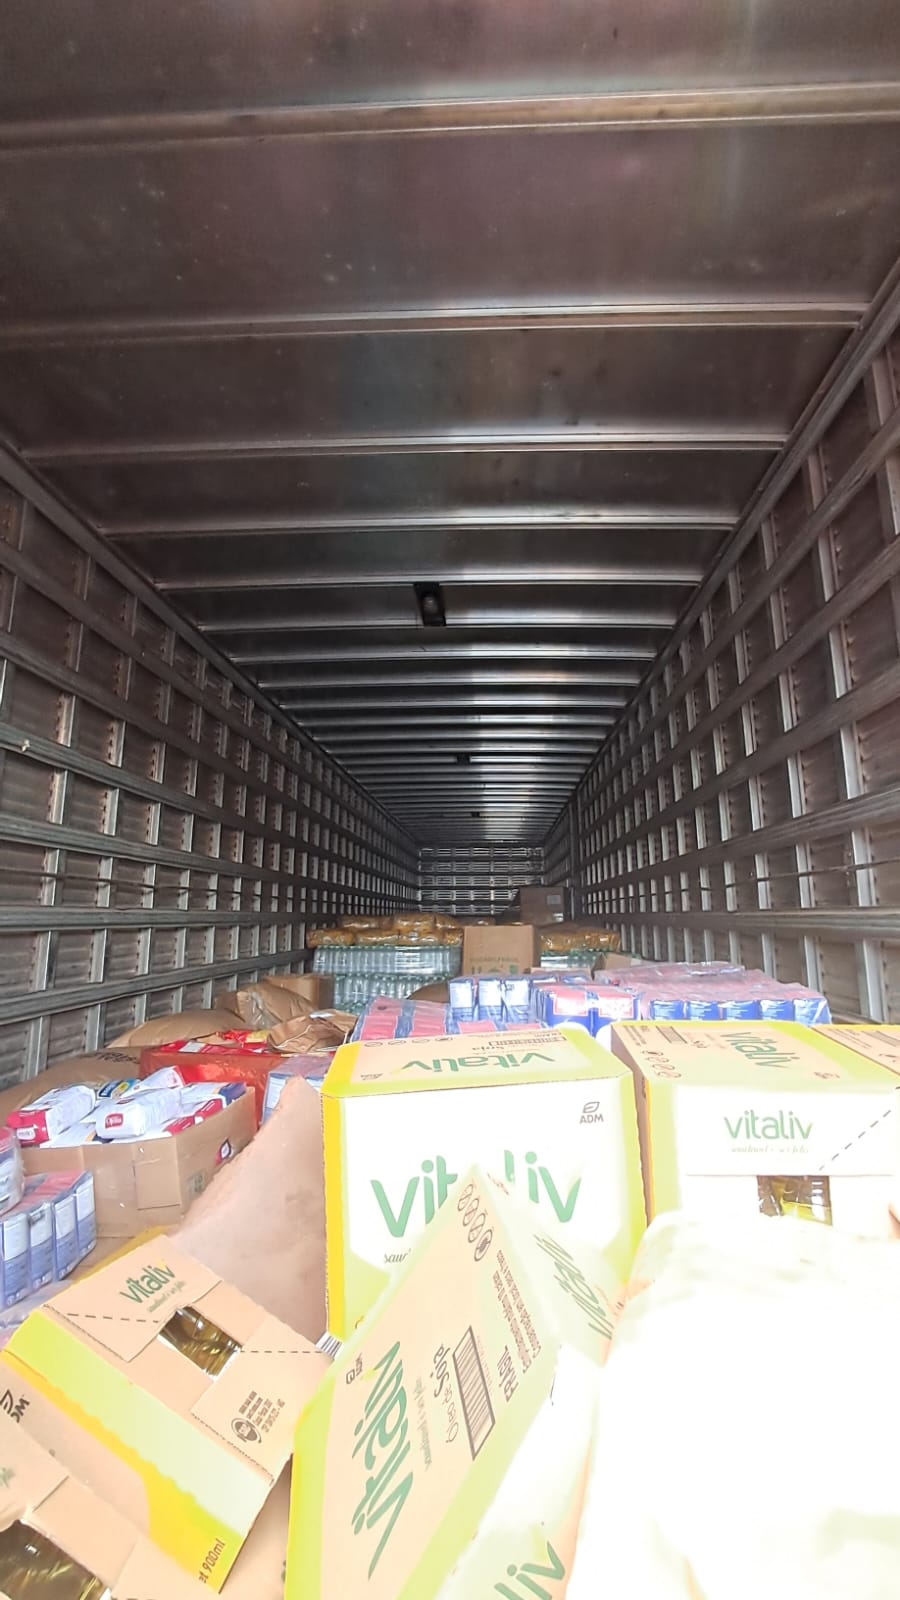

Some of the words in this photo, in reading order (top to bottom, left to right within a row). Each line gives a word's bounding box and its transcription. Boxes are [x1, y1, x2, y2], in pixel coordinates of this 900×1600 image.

[400, 1052, 555, 1073] vitaliv
[721, 1031, 800, 1068] vitaliv
[579, 1113, 604, 1124] ADM
[723, 1109, 813, 1140] vitaliv
[370, 1149, 582, 1238] vitliv
[119, 1264, 176, 1304] vitaliv
[430, 1344, 450, 1398] Soja
[497, 1345, 518, 1402] FRÁGIL
[445, 1402, 459, 1443] Óleo
[351, 1341, 414, 1581] vitaliv
[202, 1538, 225, 1572] 900ml
